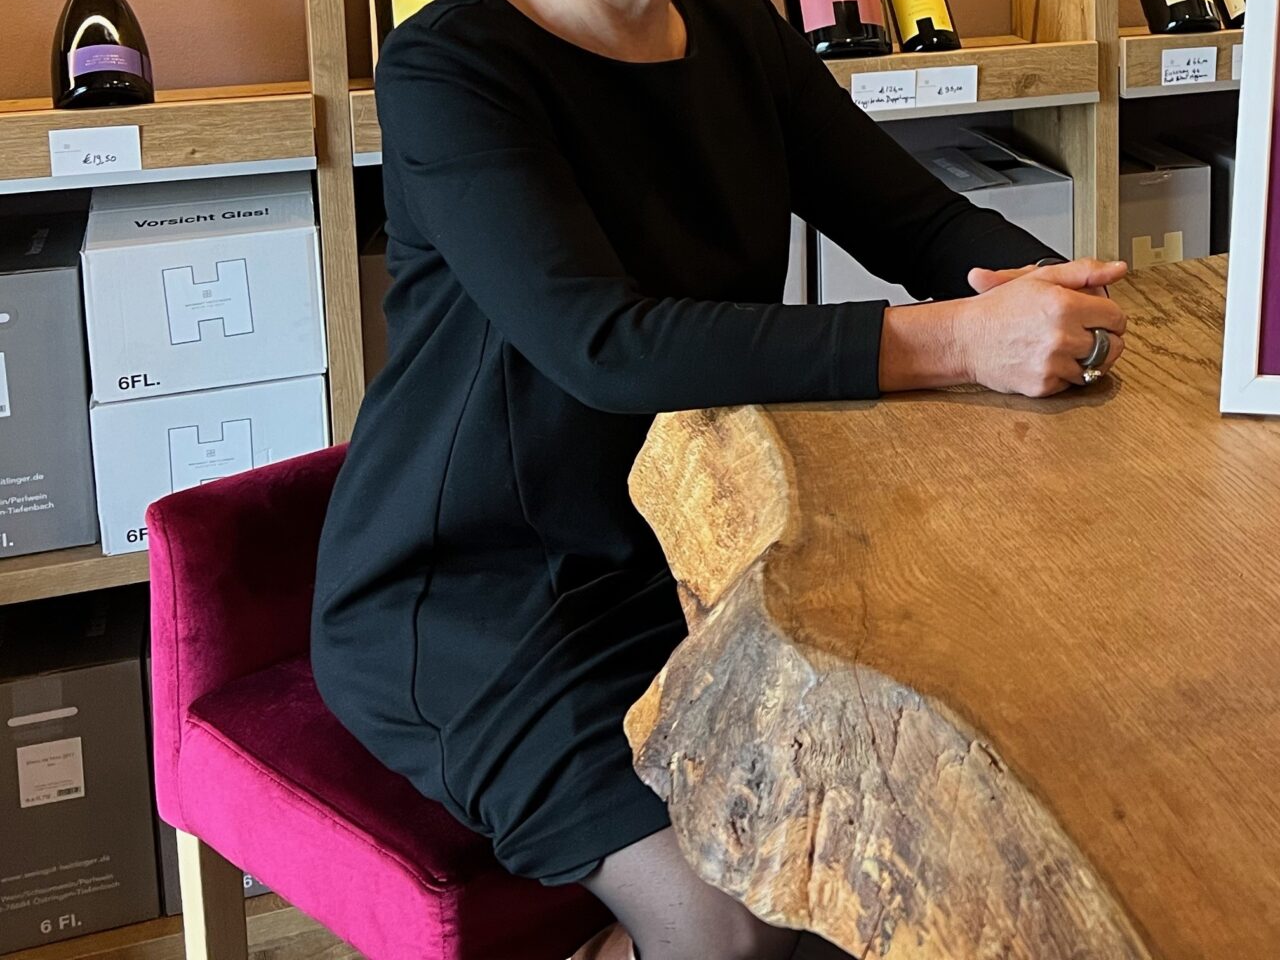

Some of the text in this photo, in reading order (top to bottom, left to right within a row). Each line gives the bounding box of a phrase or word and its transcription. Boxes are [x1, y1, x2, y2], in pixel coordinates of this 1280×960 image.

[134, 207, 270, 228] Vorsicht Glas!
[118, 373, 161, 390] 6FL.
[40, 913, 82, 933] 6 Fl.
